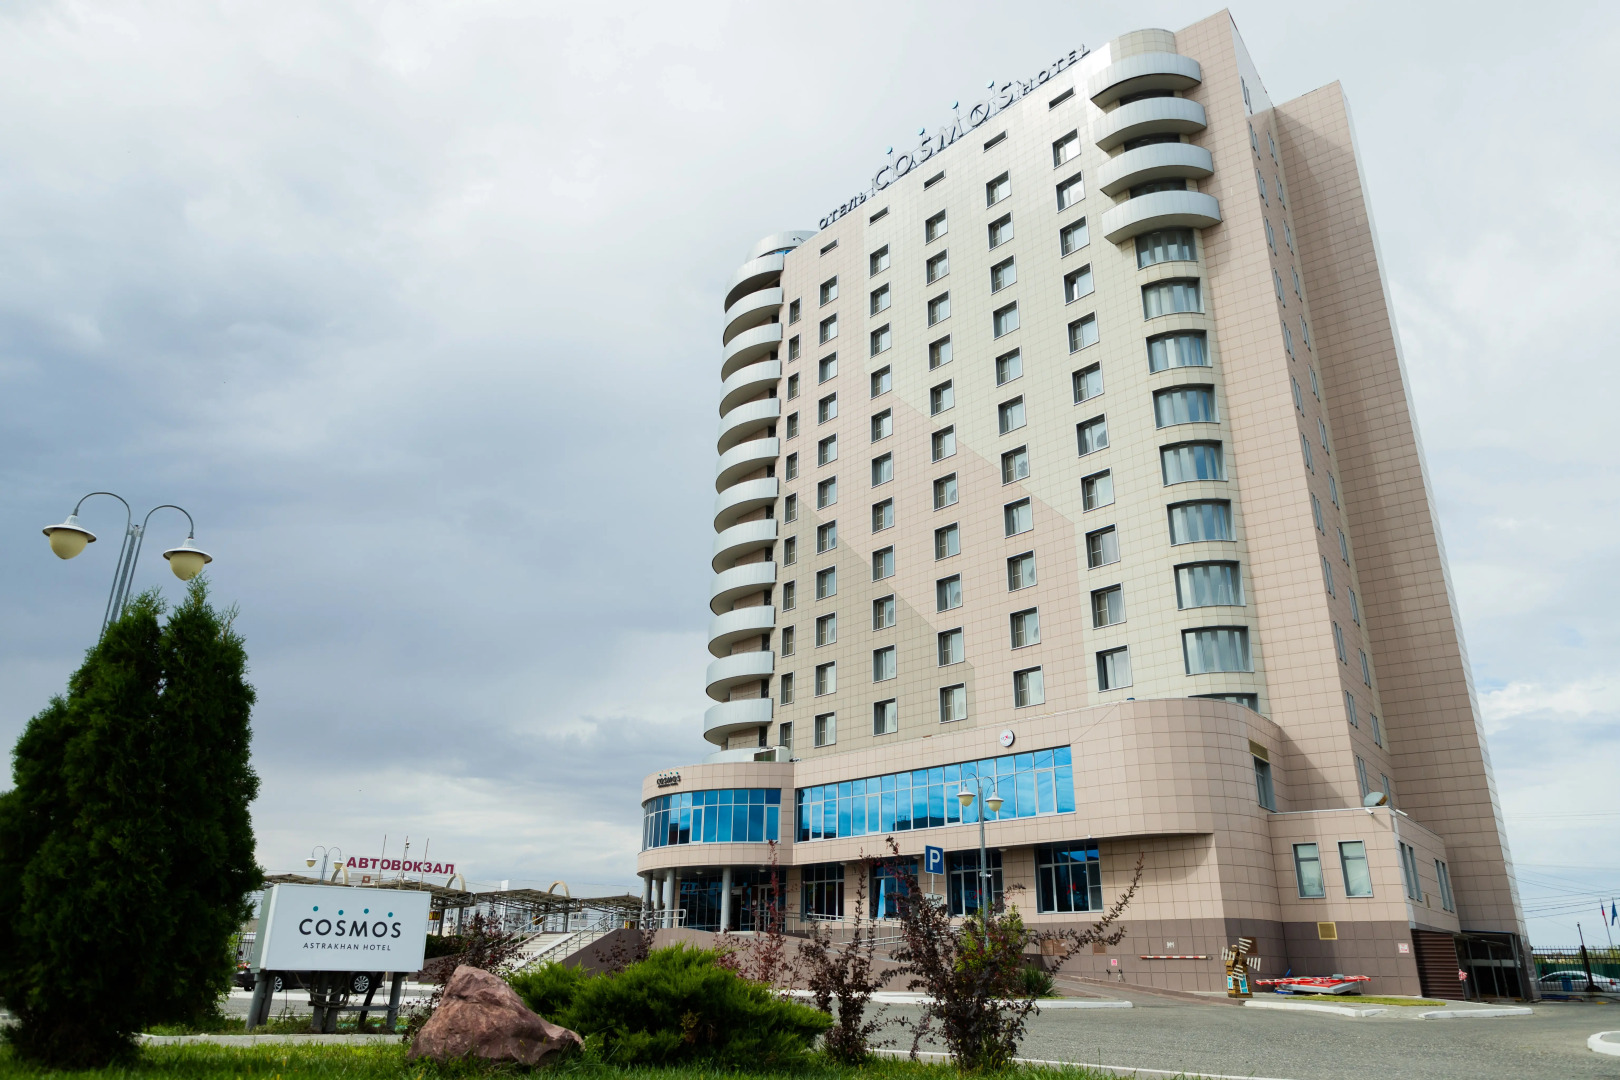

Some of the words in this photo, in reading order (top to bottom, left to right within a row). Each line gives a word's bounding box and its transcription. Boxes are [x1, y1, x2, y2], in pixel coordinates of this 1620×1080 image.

[873, 81, 1014, 191] COSMOS
[1021, 43, 1091, 96] HOTEL
[819, 192, 867, 230] ОТЕЛЬ
[346, 856, 455, 875] АВТОВОКЗАЛ
[930, 849, 941, 870] P
[299, 918, 402, 938] COSMOS
[302, 942, 360, 951] ASTRAKHAN
